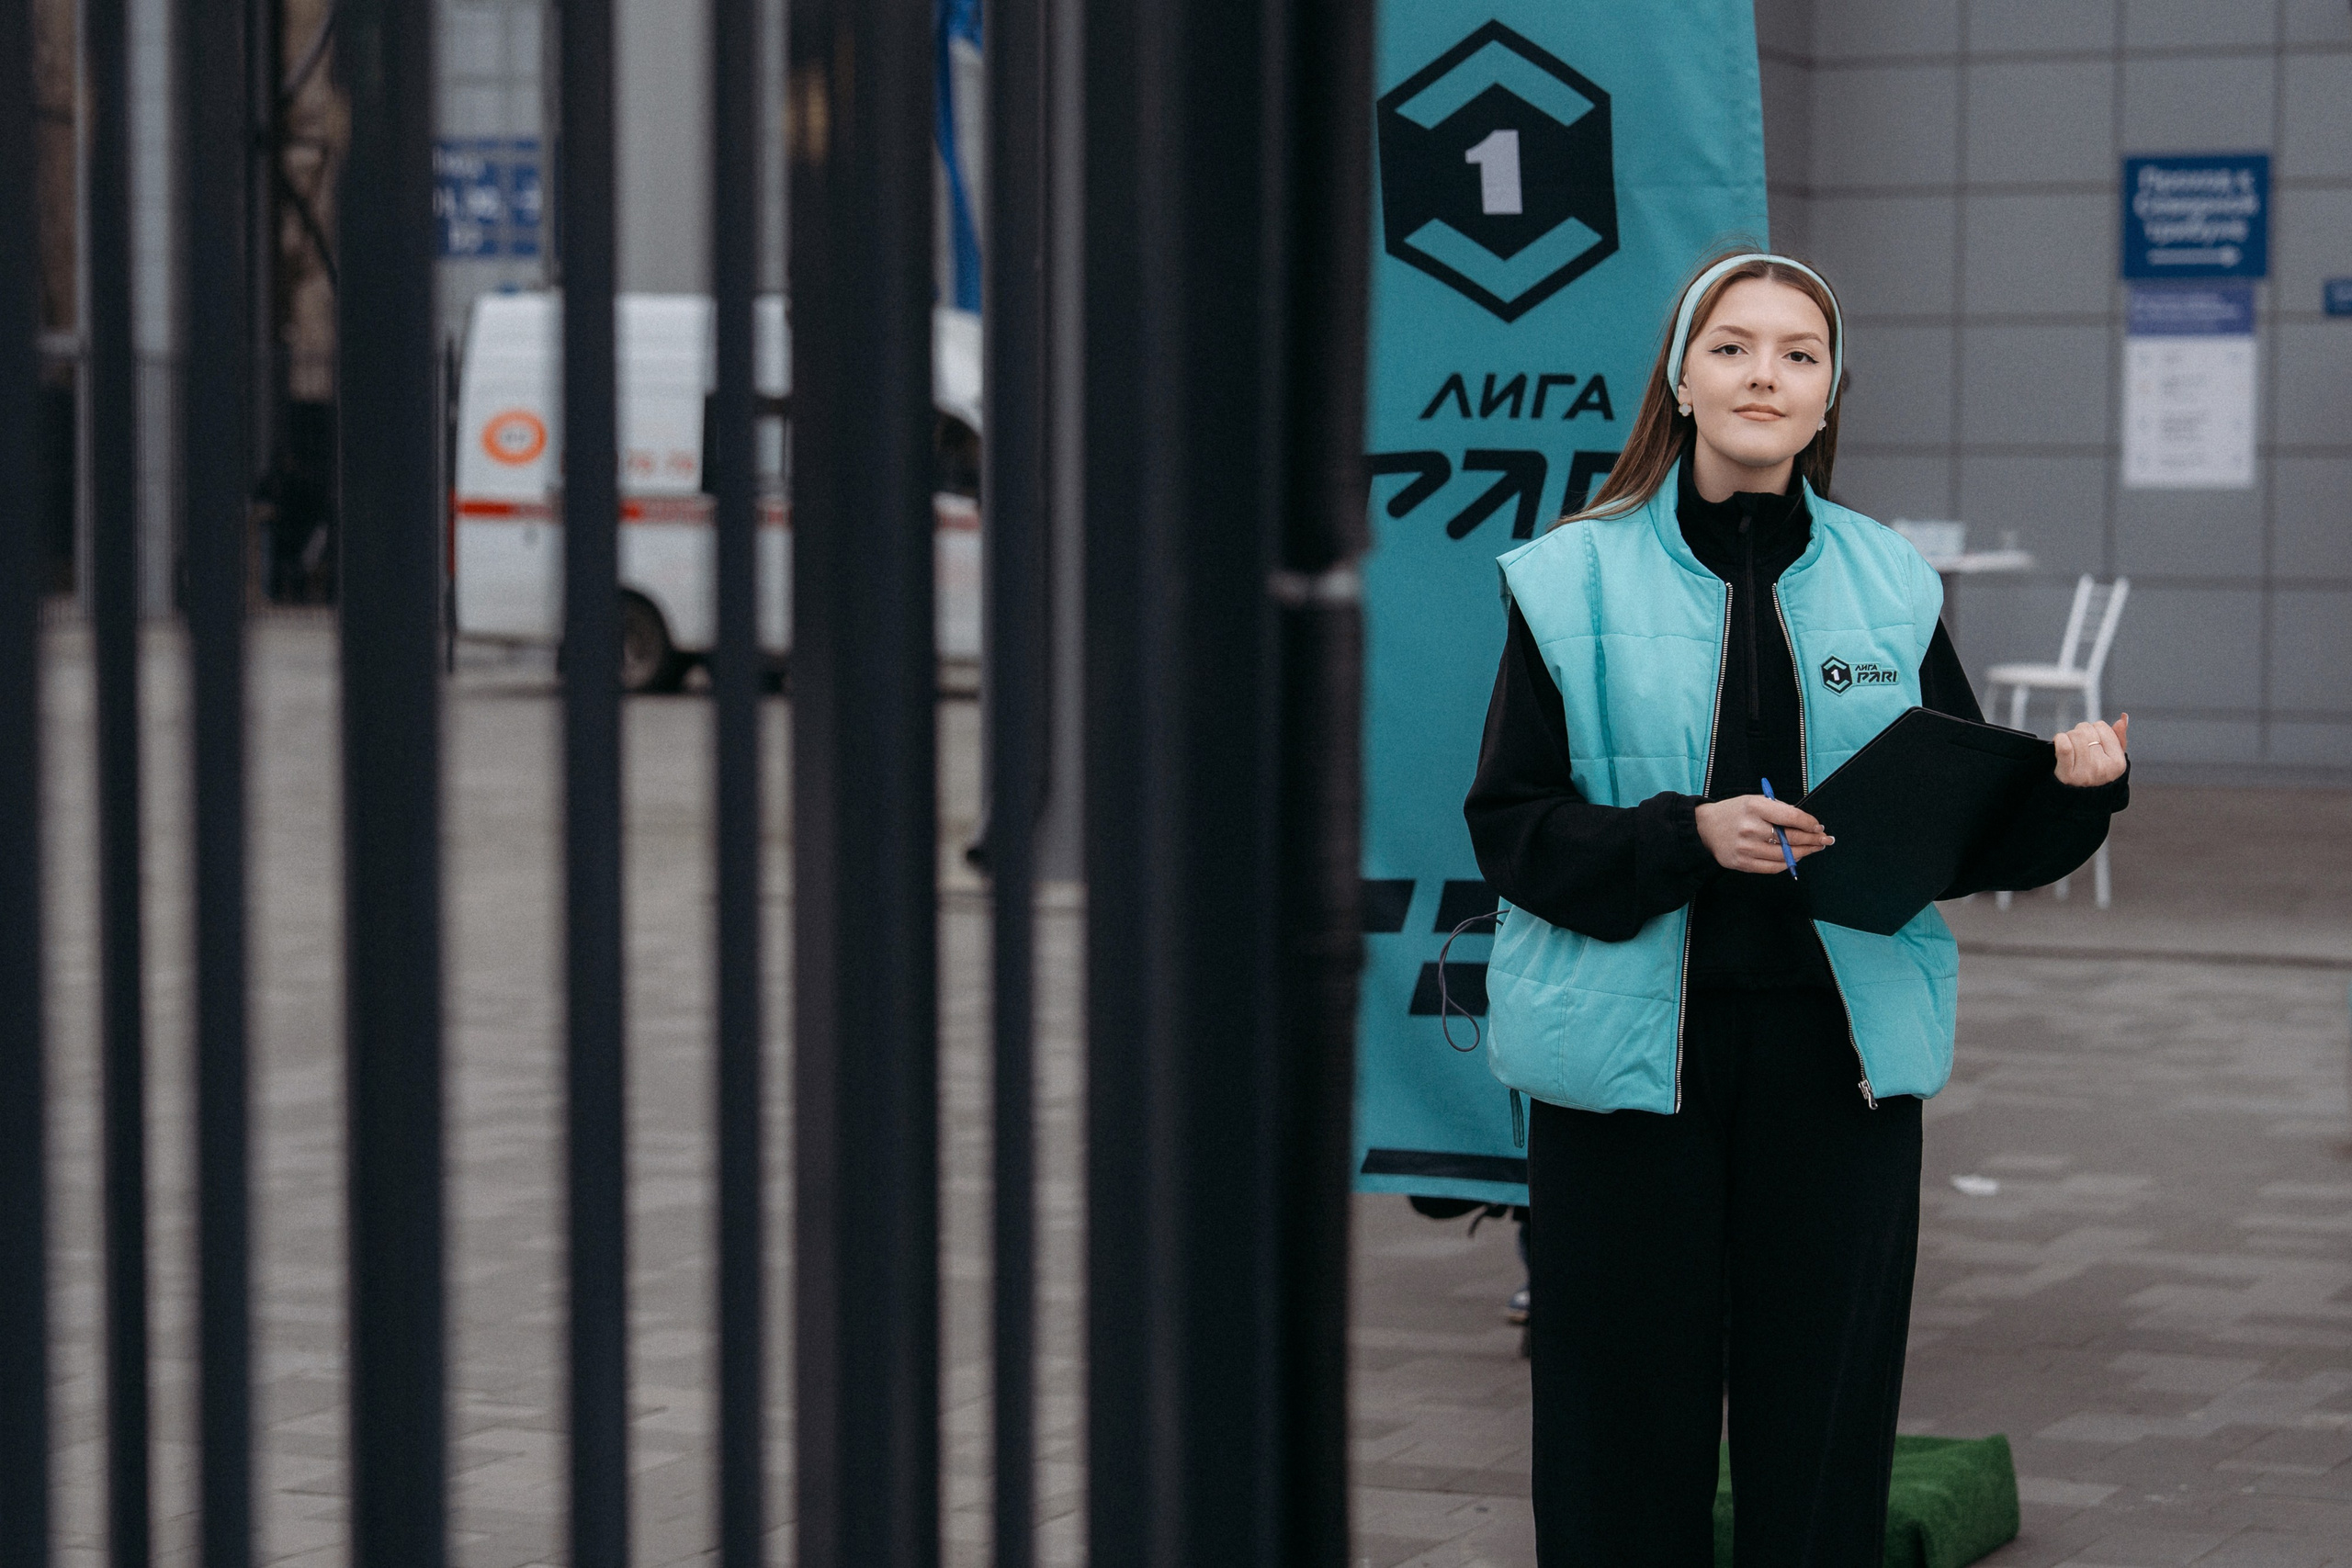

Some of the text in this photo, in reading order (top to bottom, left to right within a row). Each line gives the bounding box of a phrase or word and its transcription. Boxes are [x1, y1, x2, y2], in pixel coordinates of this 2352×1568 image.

[1465, 130, 1522, 214] 1
[1419, 373, 1615, 421] ЛИГА
[1855, 663, 1878, 671] ЛИГА
[1831, 669, 1840, 681] 1
[1857, 671, 1898, 683] PARI
